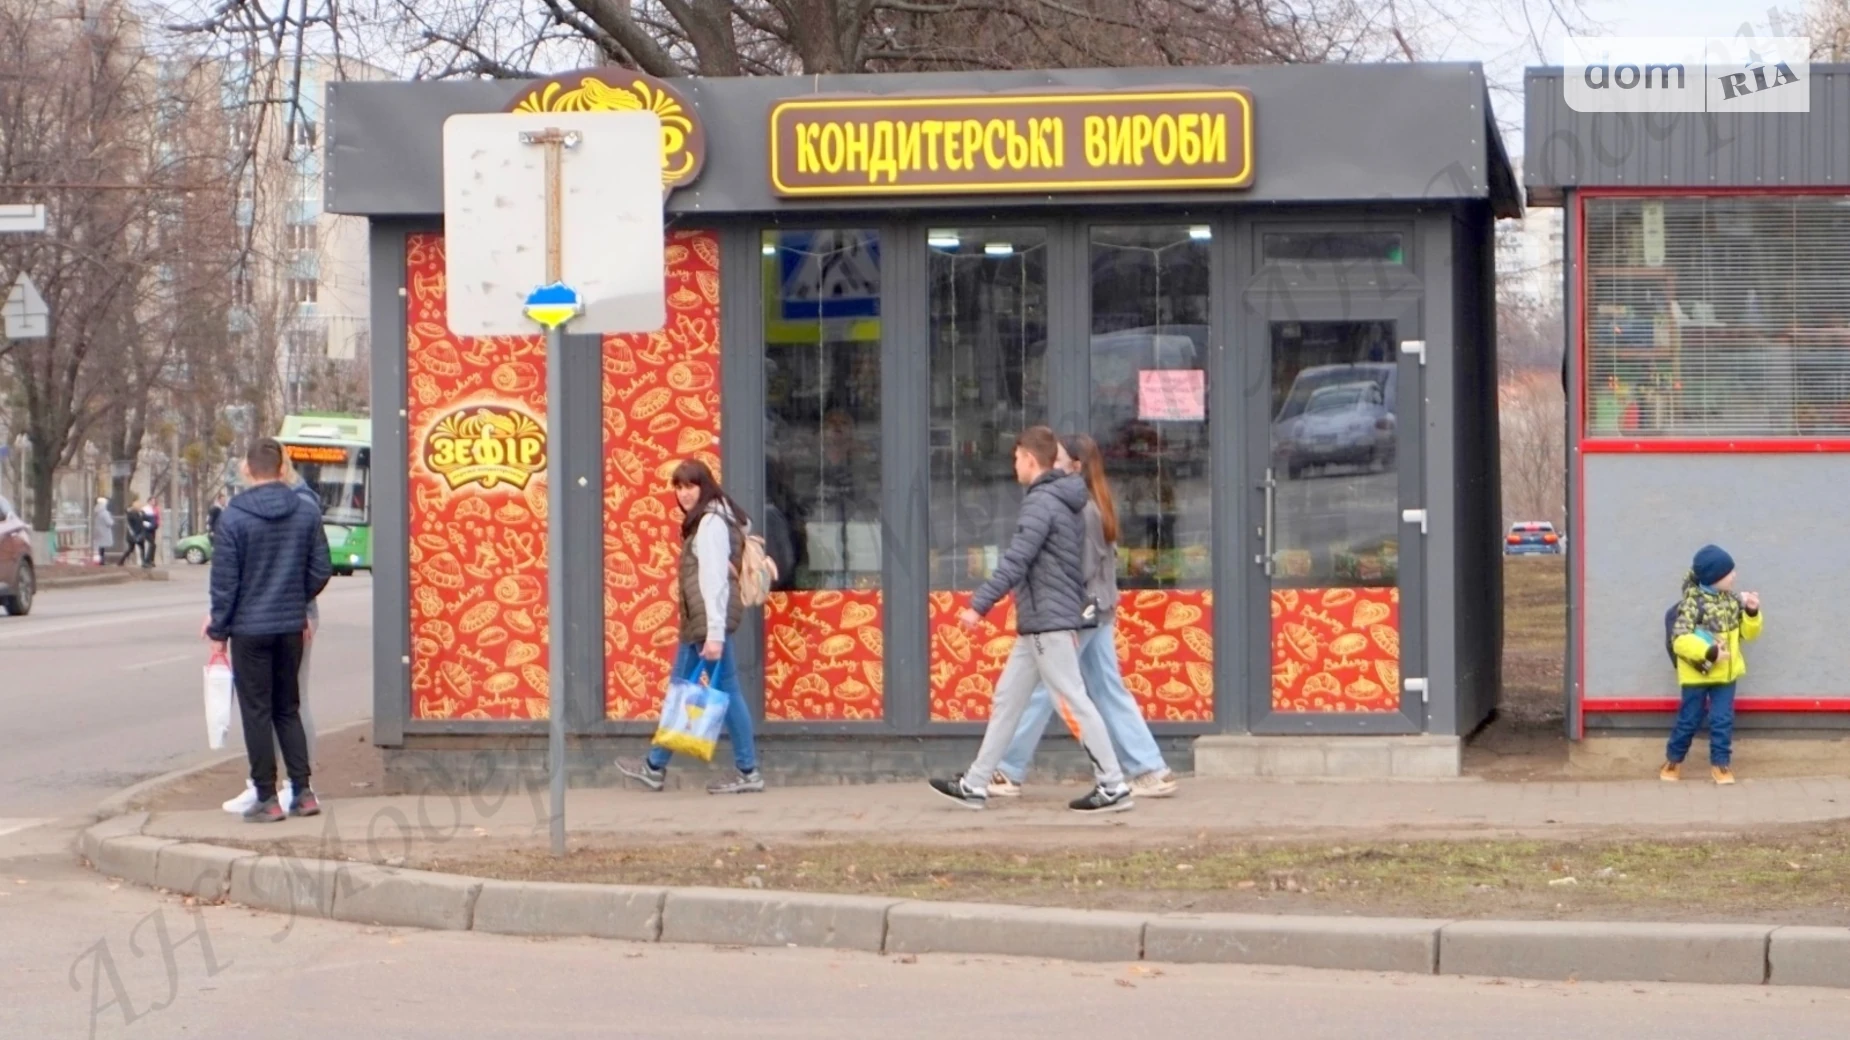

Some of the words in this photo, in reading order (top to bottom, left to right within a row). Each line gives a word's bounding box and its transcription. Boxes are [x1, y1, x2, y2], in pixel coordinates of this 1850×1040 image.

[796, 117, 1064, 182] КОНДИТЕРСЬКІ
[1084, 113, 1227, 167] ВИРОБИ
[433, 424, 541, 475] ЗЕФІР
